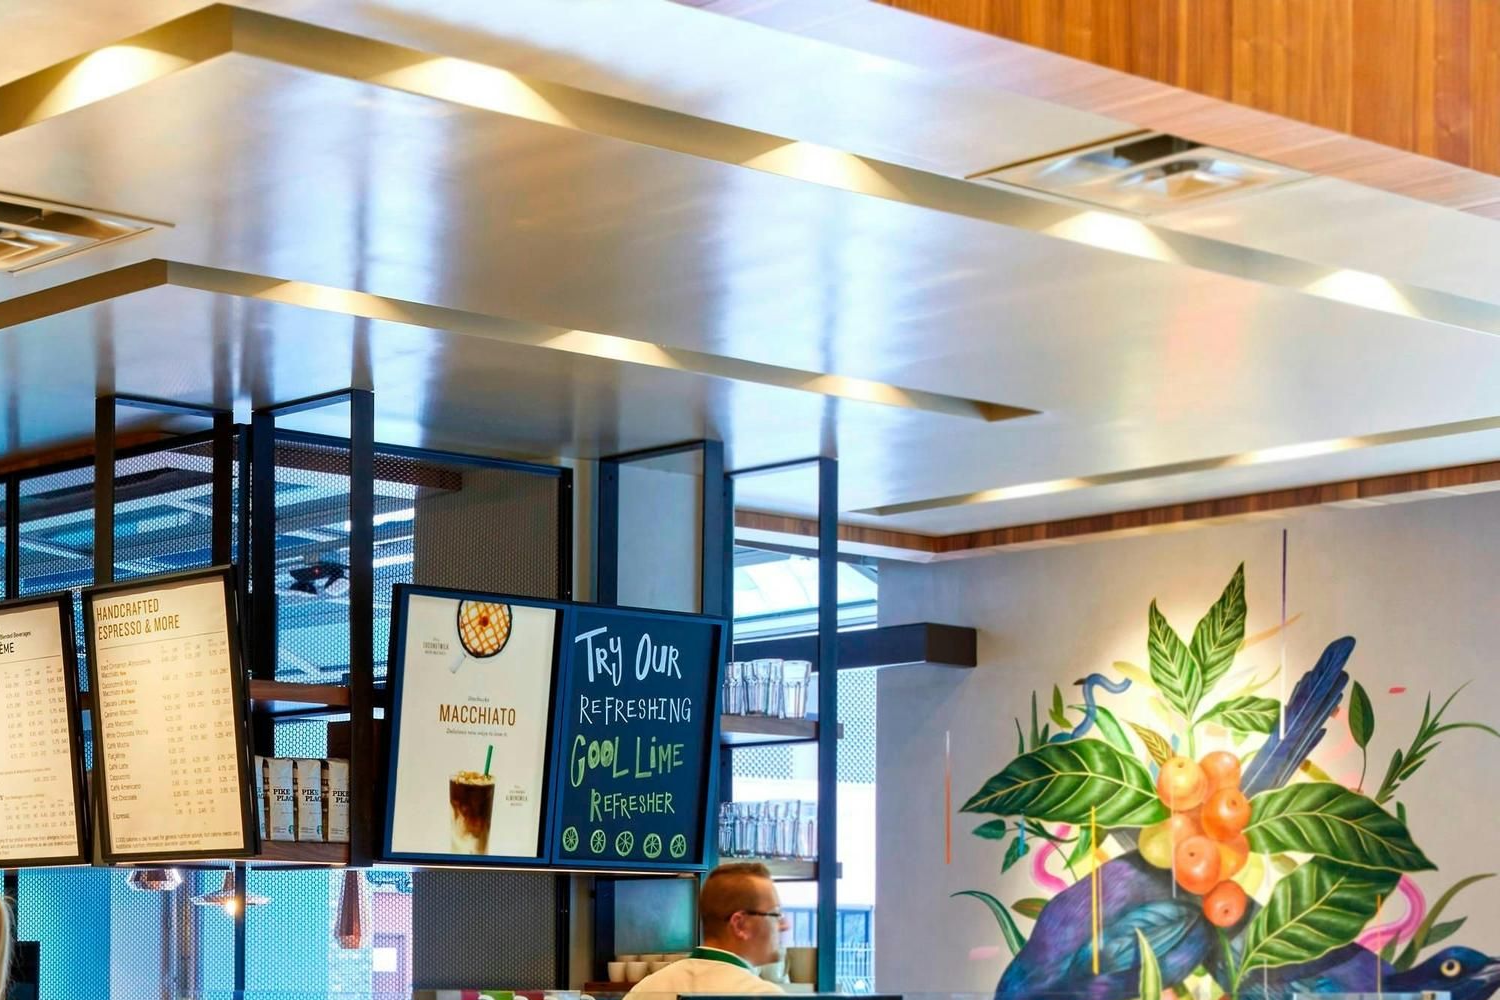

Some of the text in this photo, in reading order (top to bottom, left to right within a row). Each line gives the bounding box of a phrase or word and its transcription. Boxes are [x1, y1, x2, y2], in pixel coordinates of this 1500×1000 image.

[96, 598, 159, 621] HANDCRAFTED
[98, 614, 180, 640] ESPRESSO & MORE
[439, 703, 516, 726] MACCHIATO
